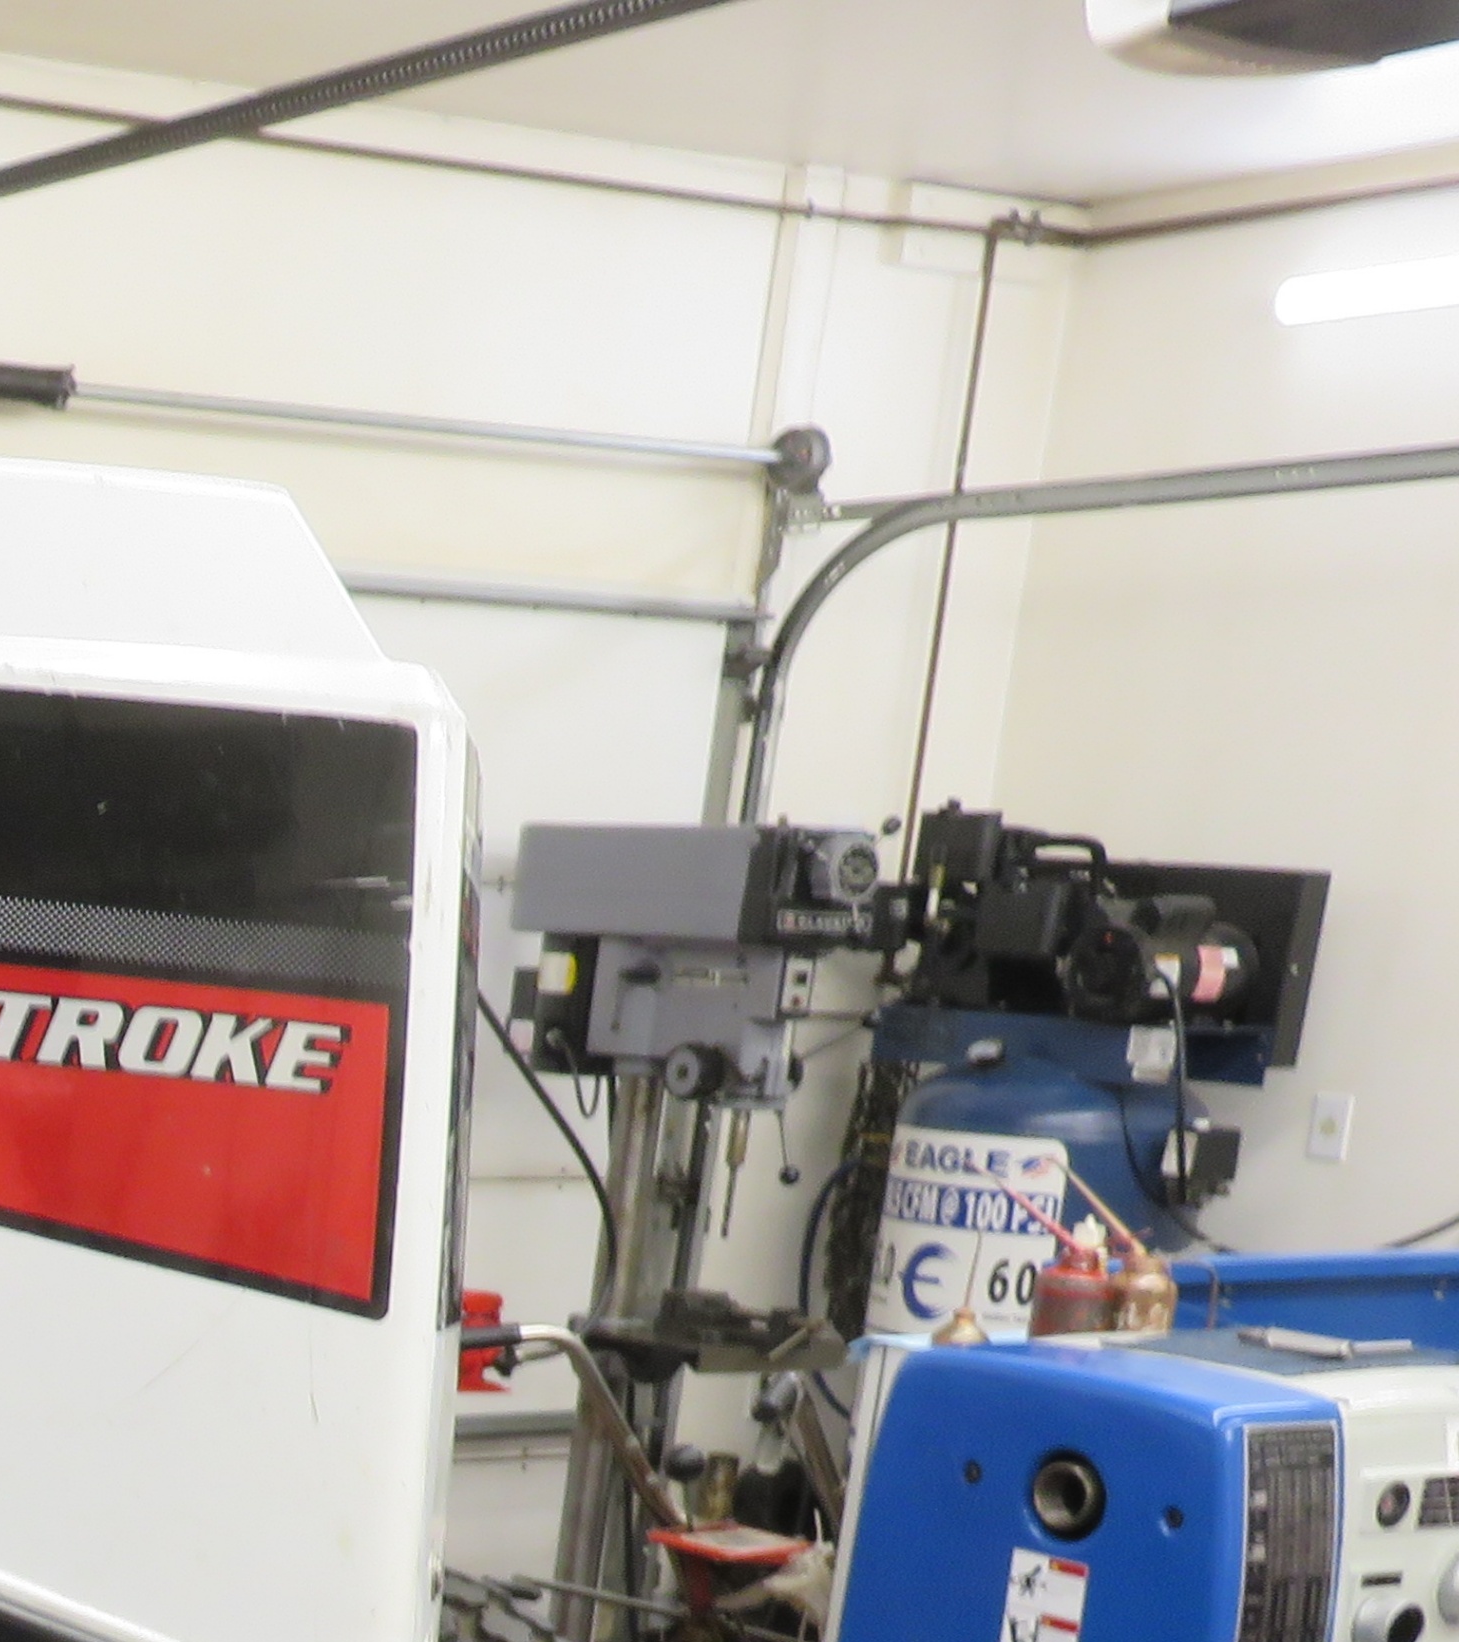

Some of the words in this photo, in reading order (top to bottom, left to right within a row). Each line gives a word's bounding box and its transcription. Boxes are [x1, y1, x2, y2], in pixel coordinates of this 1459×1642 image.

[904, 1139, 1012, 1178] EAGLE
[965, 1190, 1009, 1231] 100
[987, 1258, 1037, 1305] 60
